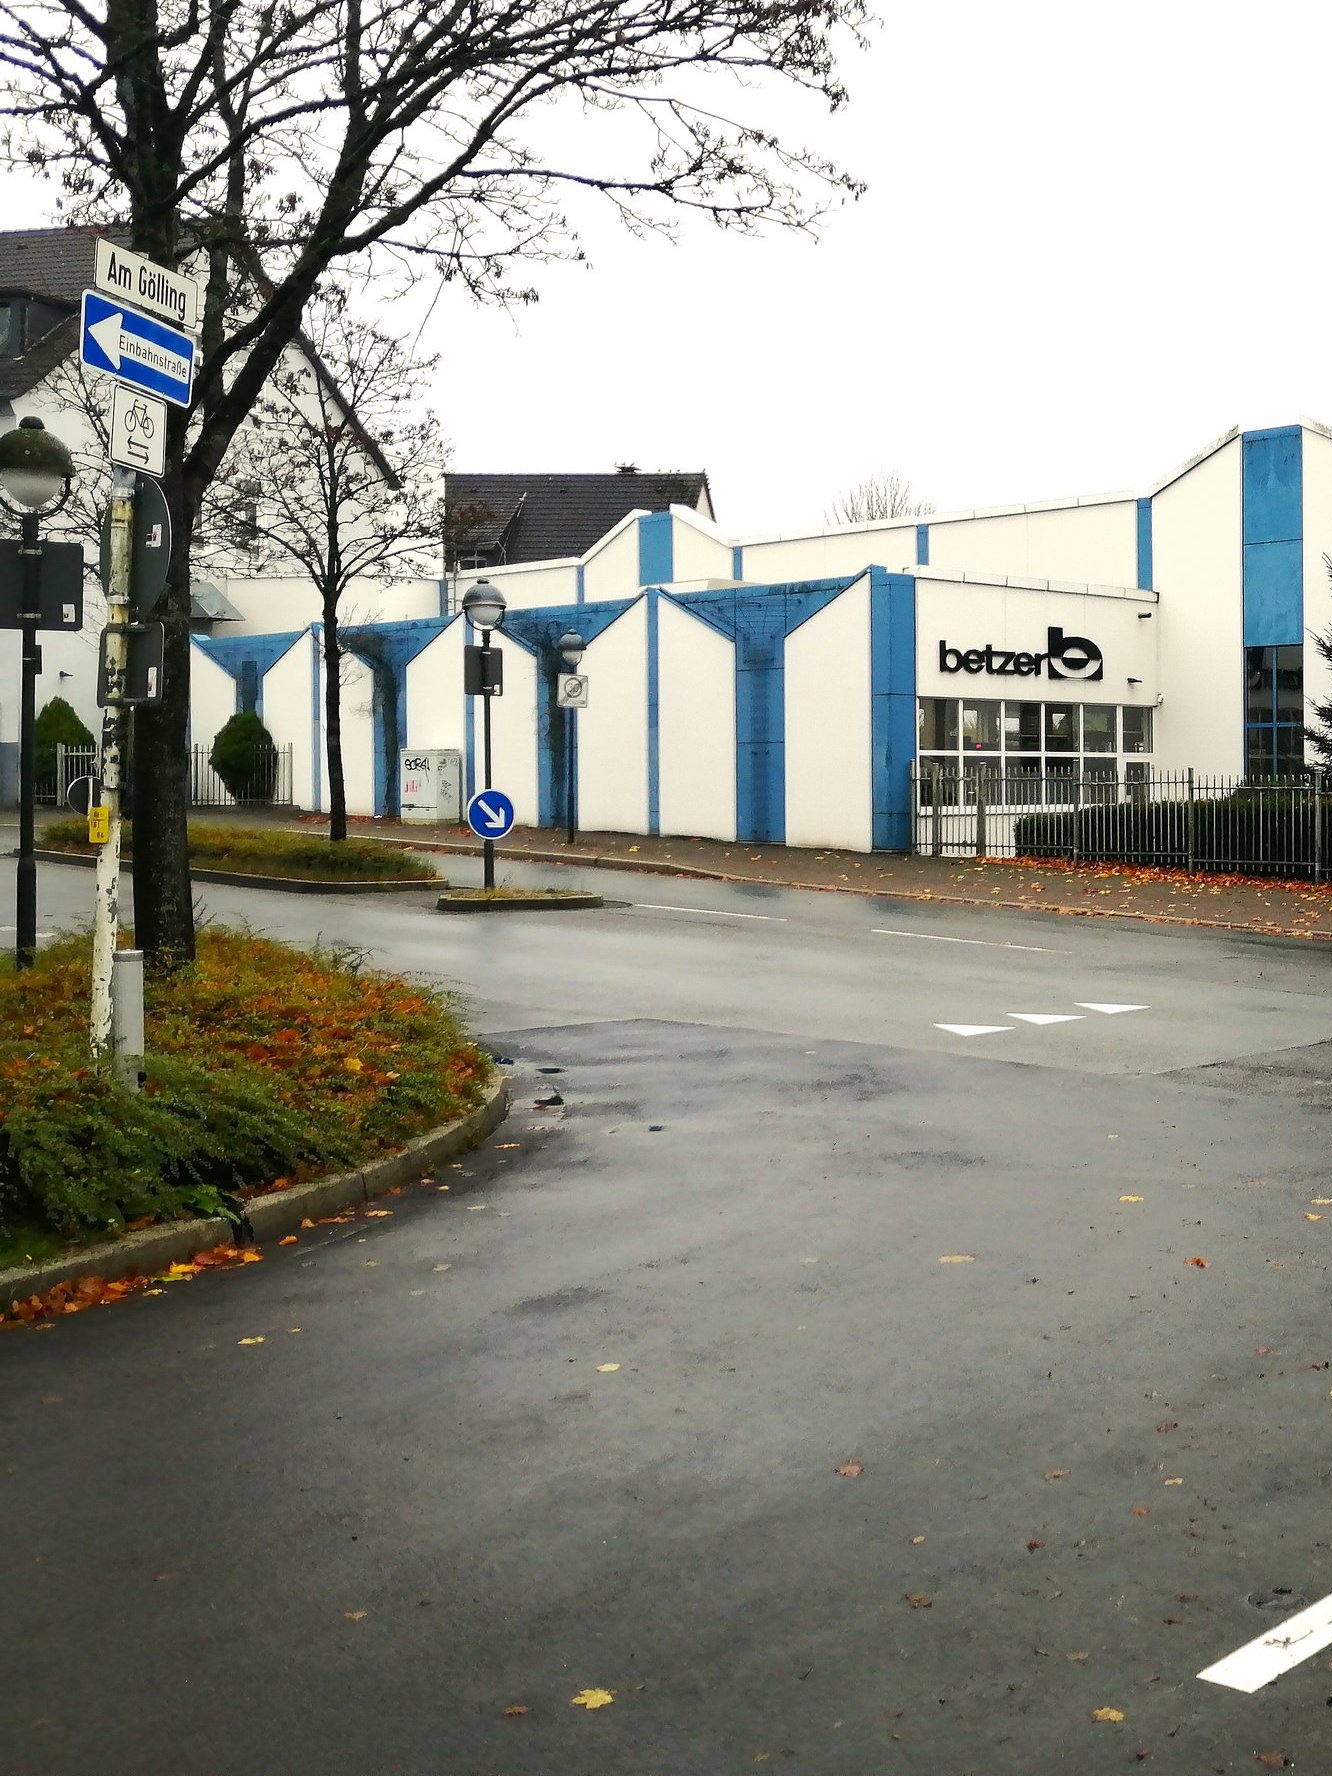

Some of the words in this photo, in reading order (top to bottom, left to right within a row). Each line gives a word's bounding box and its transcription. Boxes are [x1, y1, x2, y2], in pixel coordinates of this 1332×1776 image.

[107, 251, 132, 290] Am
[138, 265, 187, 321] Gölling
[118, 334, 188, 378] Einbahnstraße
[939, 640, 1049, 677] betzer
